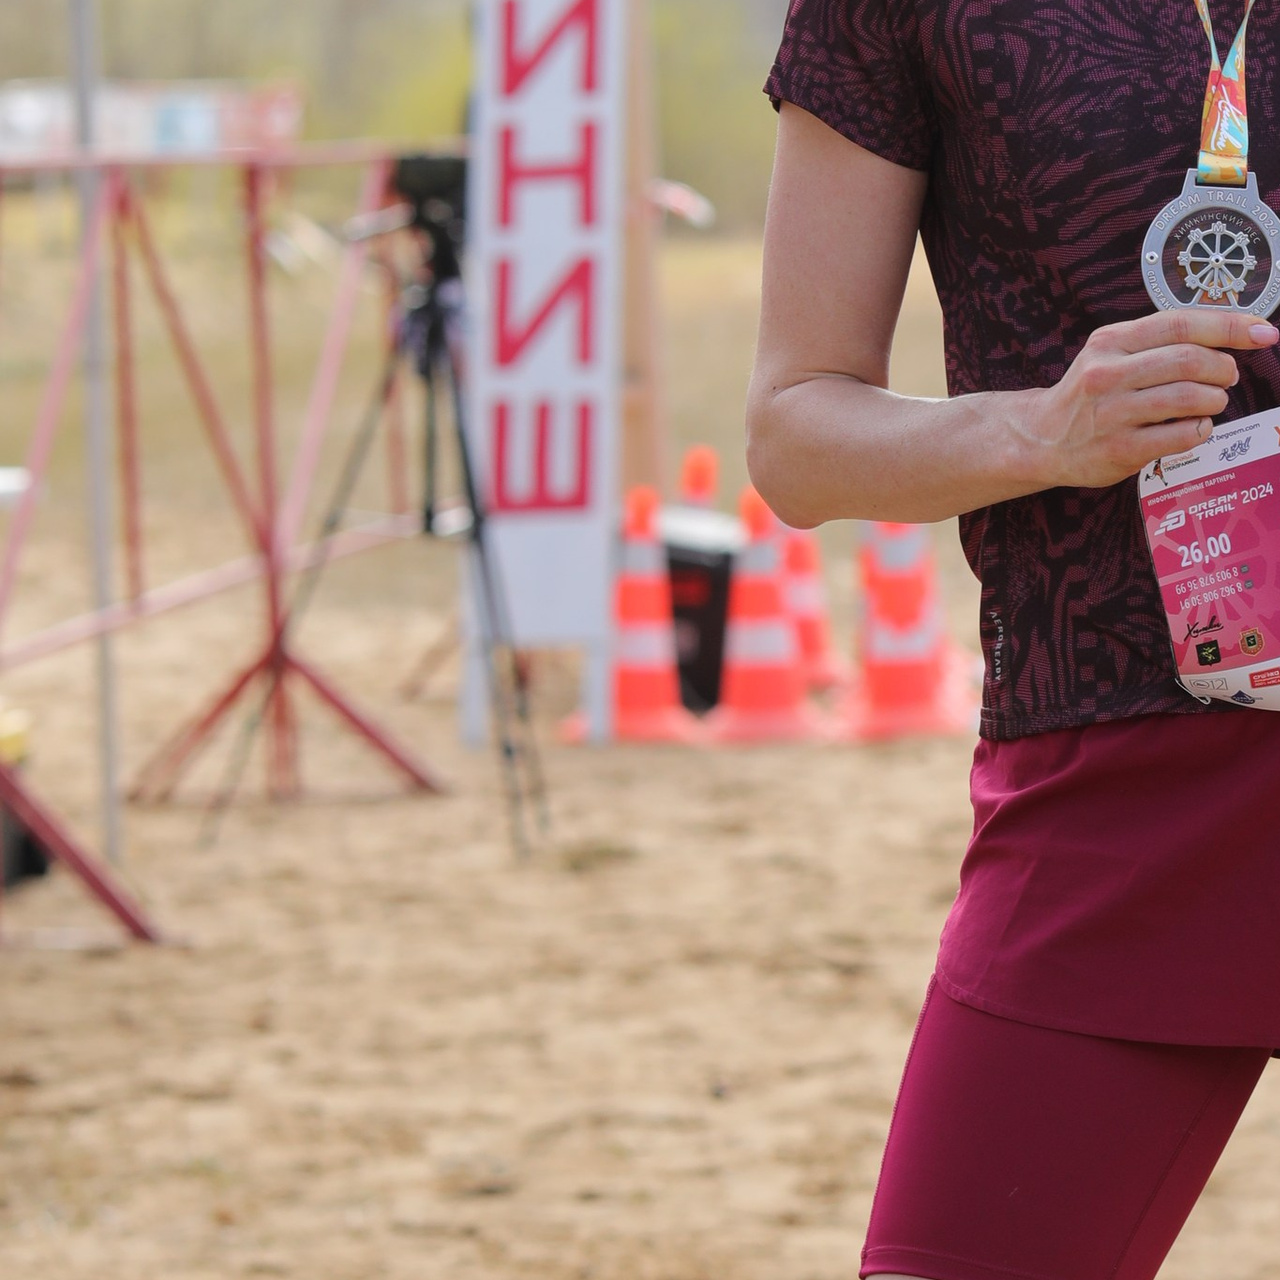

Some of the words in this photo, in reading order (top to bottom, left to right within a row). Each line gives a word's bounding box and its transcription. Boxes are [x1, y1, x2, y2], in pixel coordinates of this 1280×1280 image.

[1155, 193, 1201, 231] DREAM
[1207, 190, 1248, 208] TRAIL
[1252, 205, 1279, 237] 2024
[1174, 212, 1244, 241] ХИМКИНСКИЙ
[1245, 226, 1262, 245] ЛЕС
[1216, 423, 1260, 441] begoem.com
[1147, 482, 1205, 506] ИНФОРМАЦИОННЫЕ
[1204, 472, 1236, 487] ПАРТНЕРЫ
[1188, 491, 1238, 515] DREAM
[1241, 482, 1274, 504] 2024
[1196, 504, 1236, 520] TRAIL
[1177, 532, 1232, 568] 26,00
[1216, 570, 1232, 582] 903
[1232, 566, 1238, 577] 8
[1187, 580, 1199, 591] 36
[1199, 574, 1216, 588] 978
[1236, 582, 1243, 592] 8
[1175, 584, 1187, 595] 99
[1203, 590, 1219, 603] 908
[1192, 595, 1202, 606] 30
